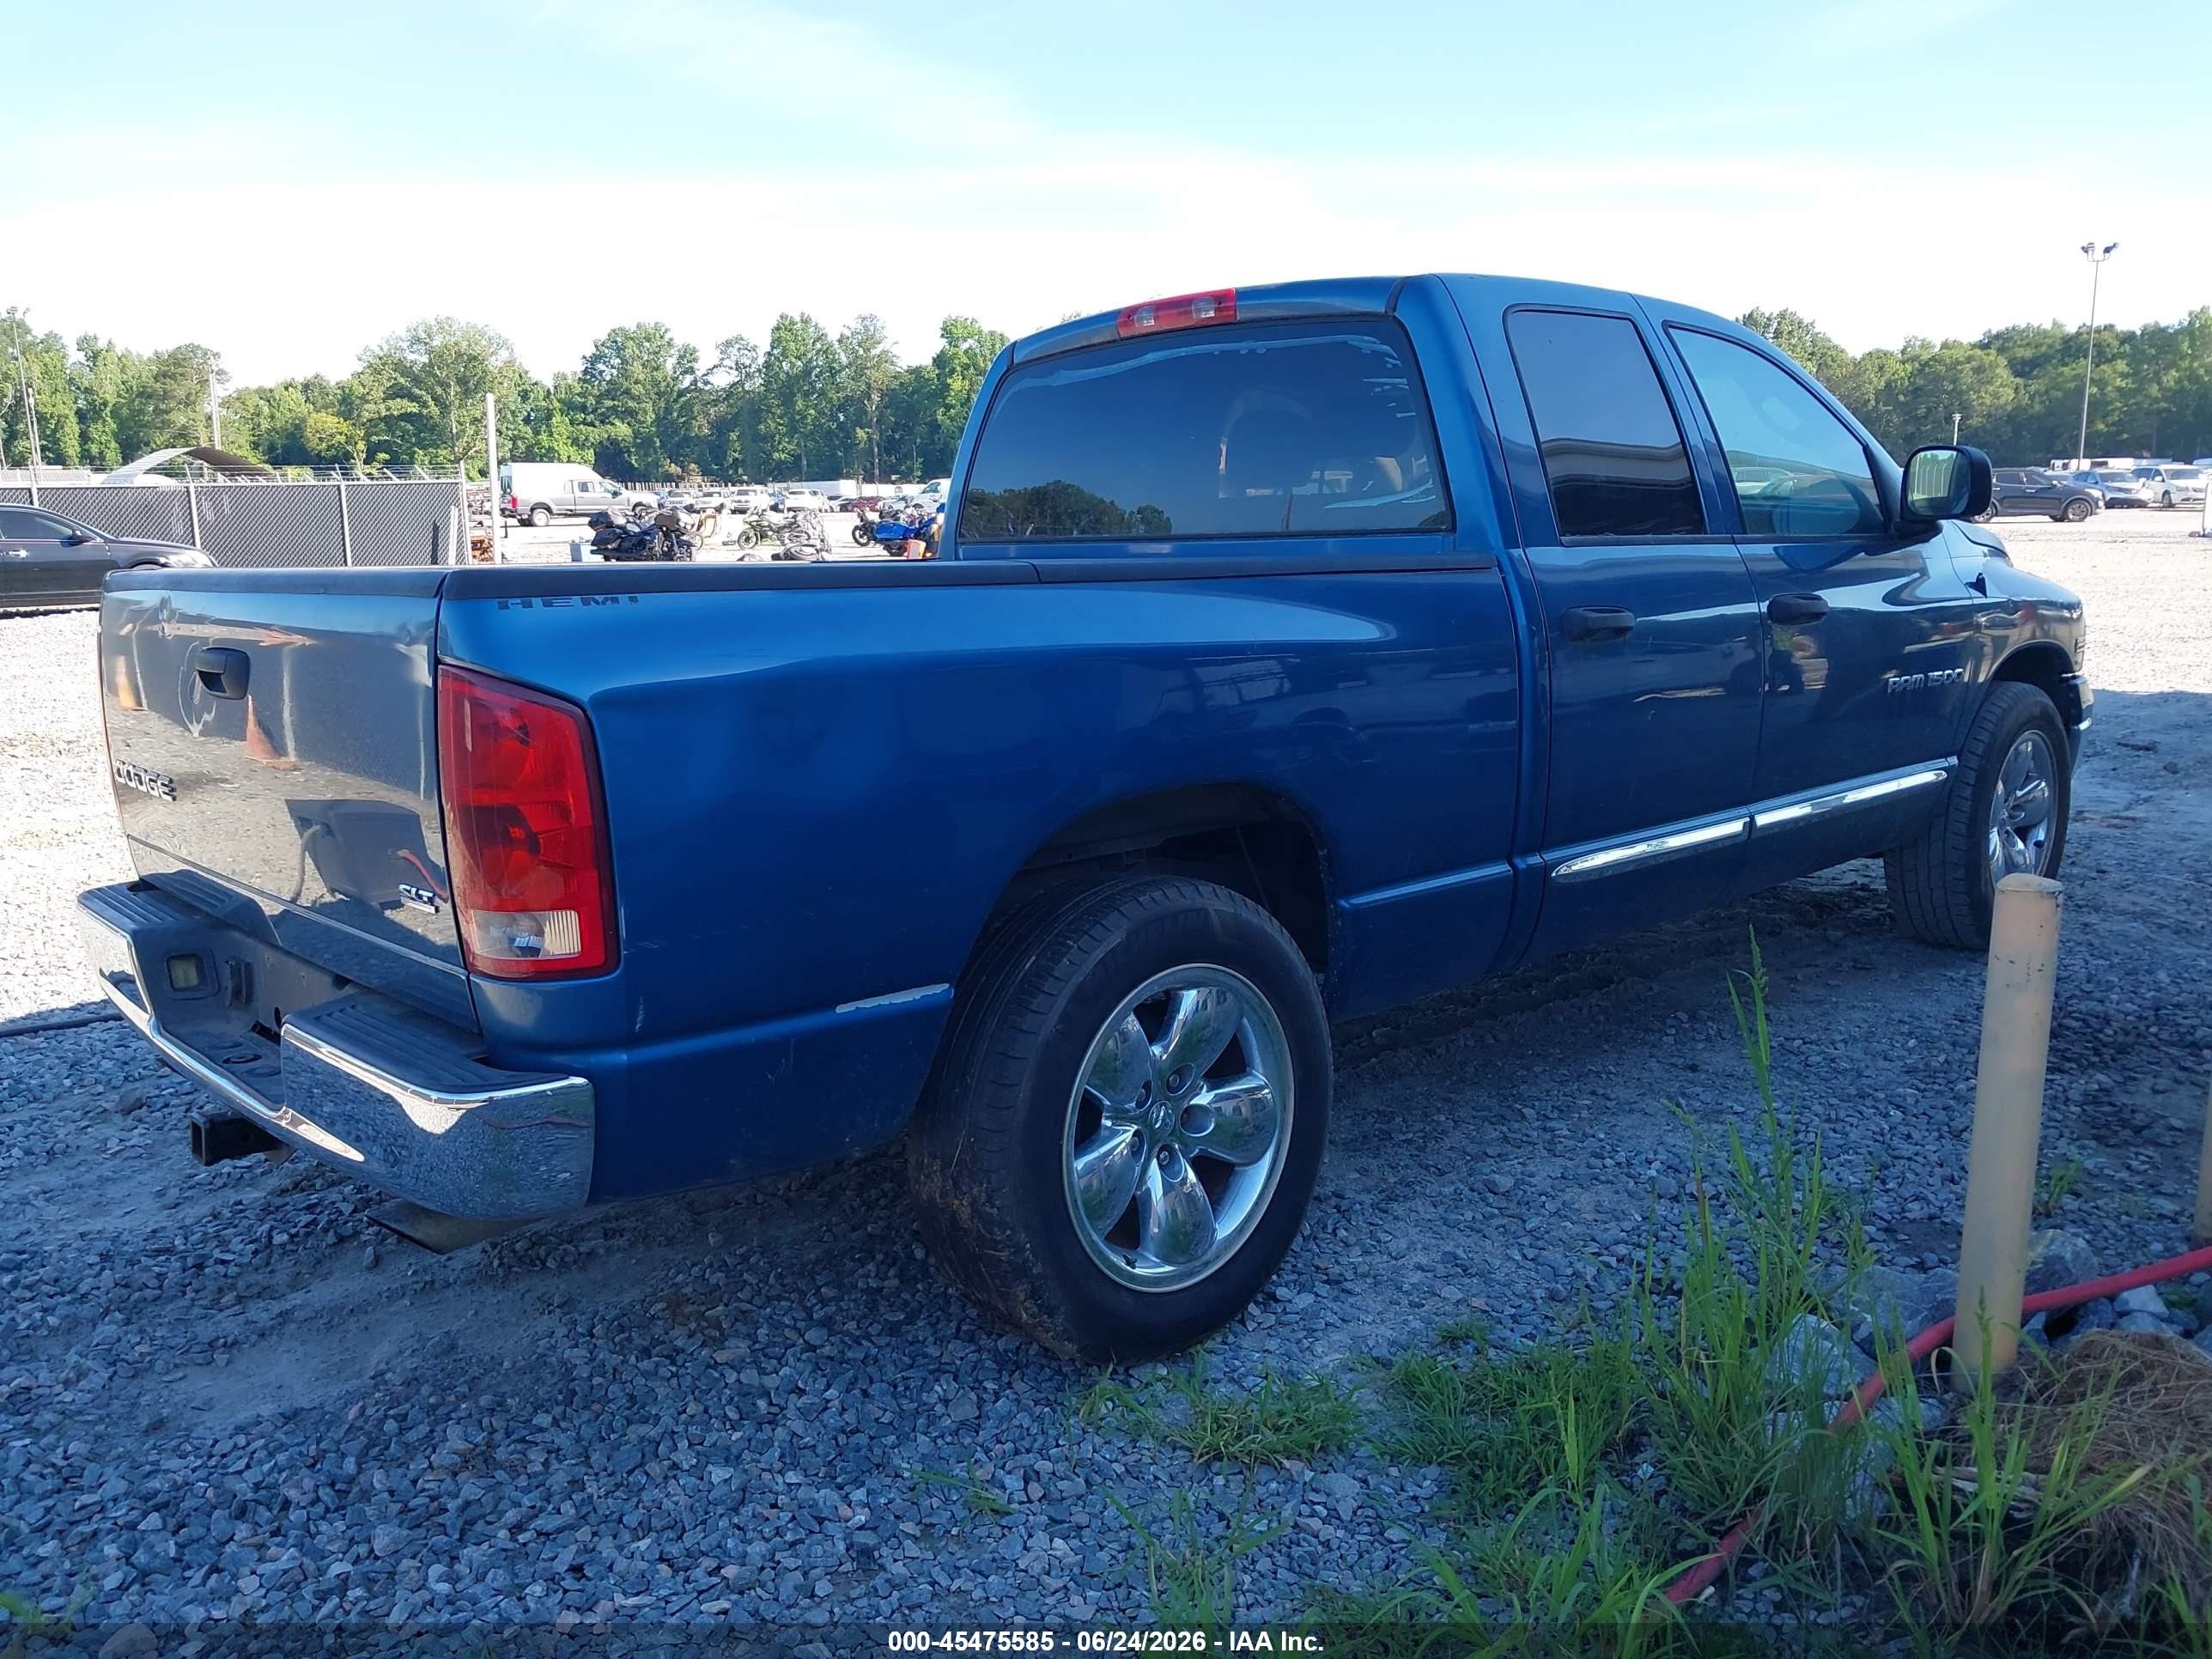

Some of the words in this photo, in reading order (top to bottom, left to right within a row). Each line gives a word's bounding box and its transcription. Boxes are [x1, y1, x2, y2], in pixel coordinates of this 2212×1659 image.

[496, 595, 640, 611] HEMI
[1887, 675, 1924, 693] RAM
[1927, 668, 1964, 687] 1500
[115, 759, 177, 802] DODGE
